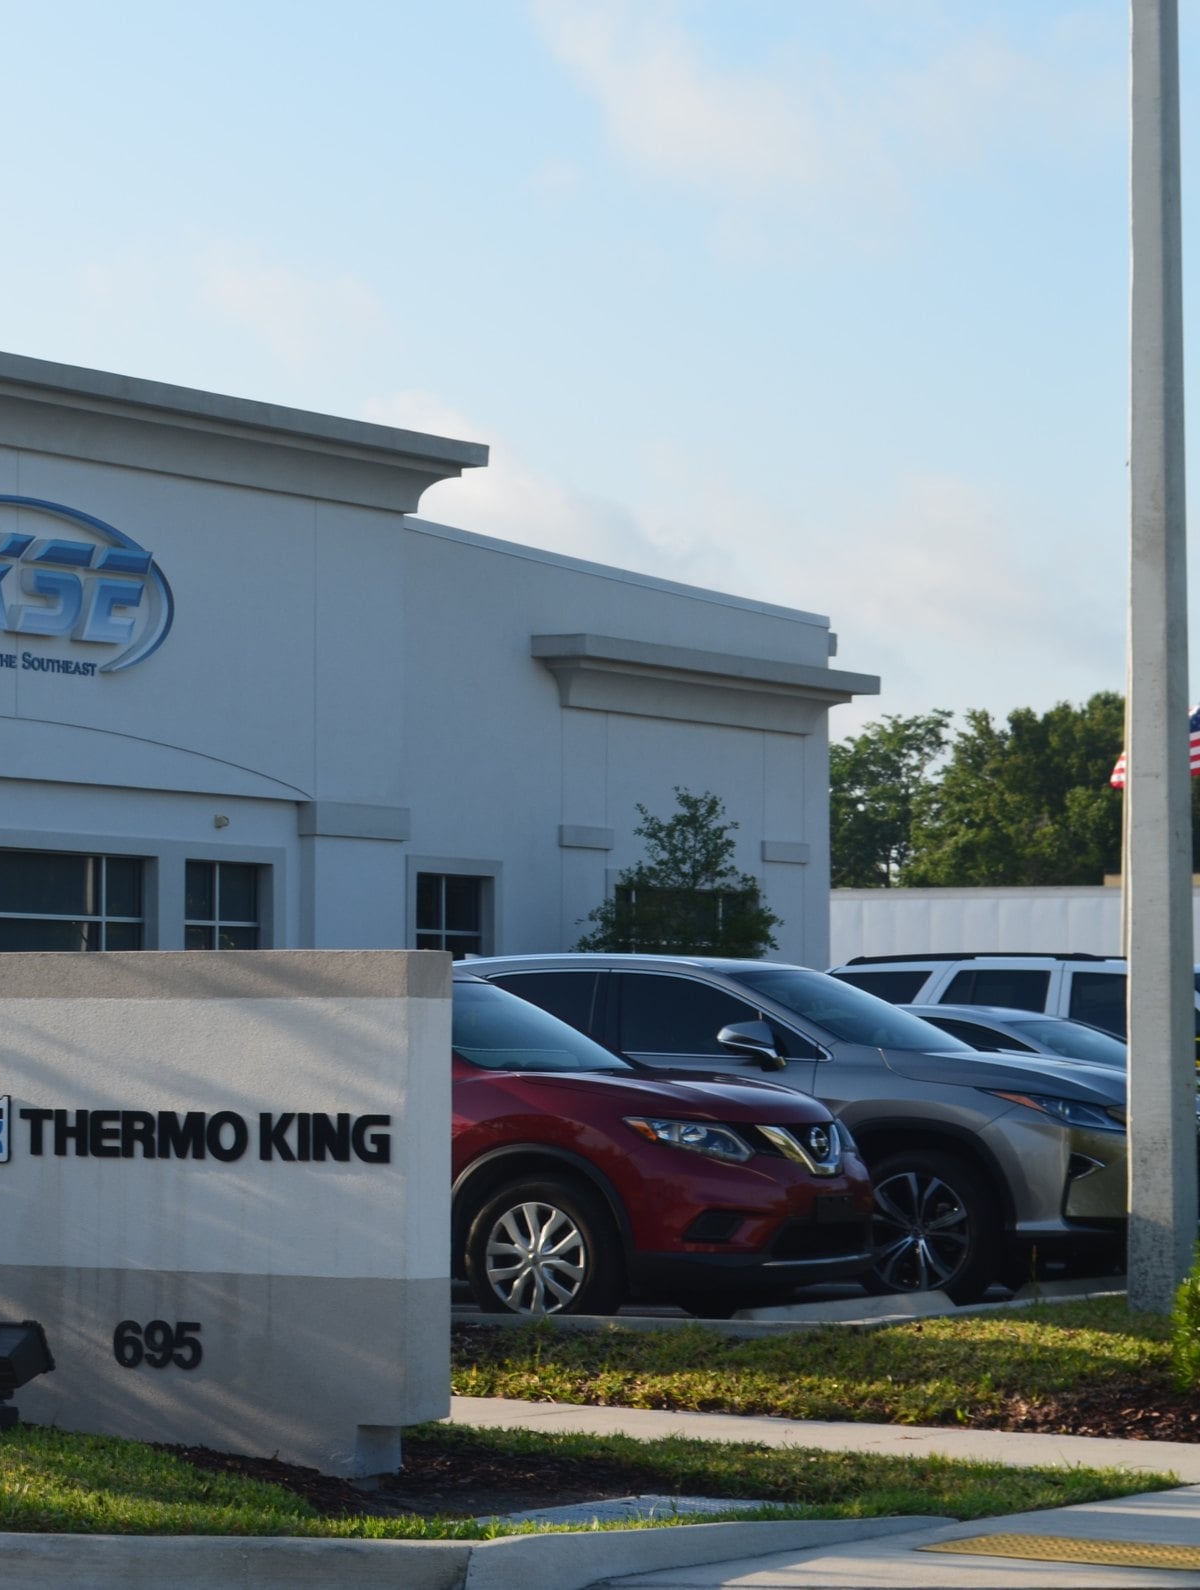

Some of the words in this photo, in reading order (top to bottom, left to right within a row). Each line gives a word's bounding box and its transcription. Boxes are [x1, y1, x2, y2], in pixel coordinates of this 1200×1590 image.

[20, 1108, 249, 1163] THERMO
[259, 1112, 392, 1164] KING
[113, 1319, 203, 1371] 695
